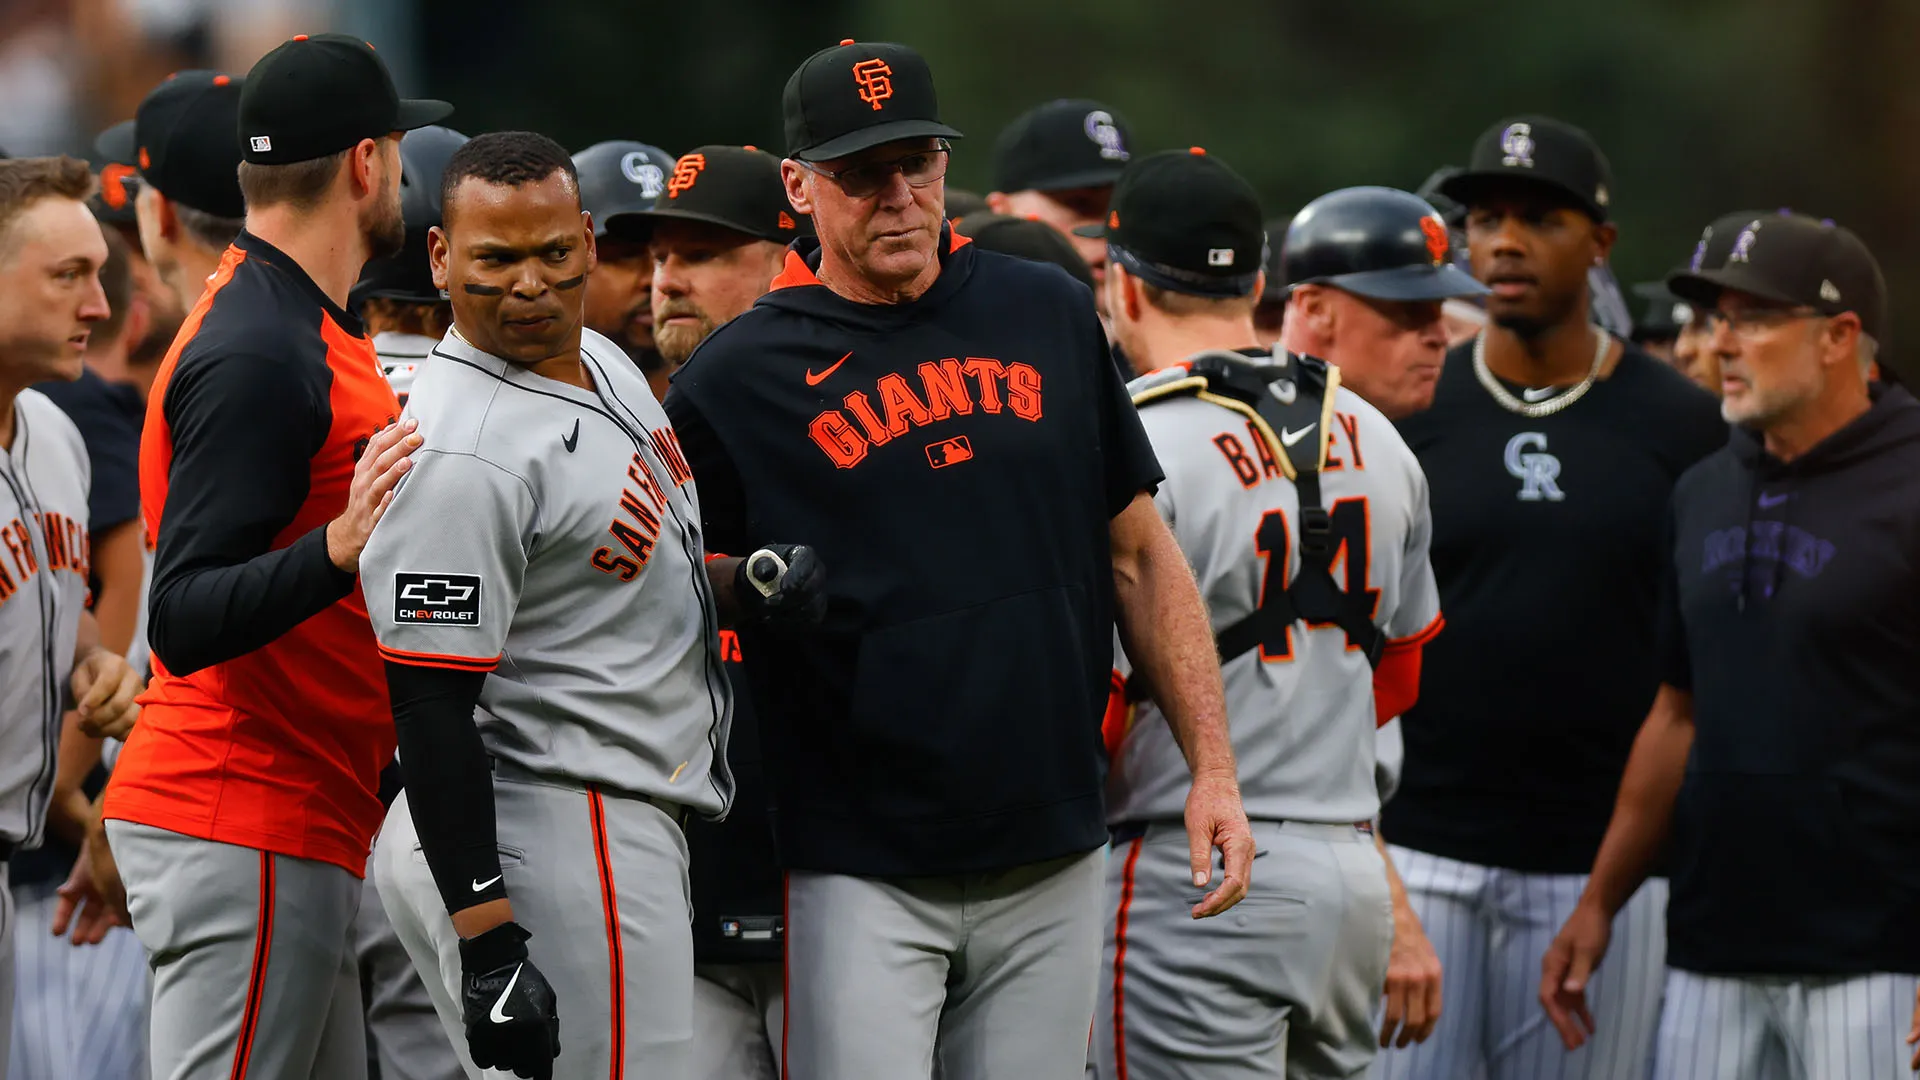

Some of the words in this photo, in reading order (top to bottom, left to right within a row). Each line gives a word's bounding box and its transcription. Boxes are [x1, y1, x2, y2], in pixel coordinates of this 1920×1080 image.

[852, 57, 893, 111] SF
[668, 153, 706, 199] SF
[808, 356, 1043, 469] GIANTS
[1503, 431, 1566, 501] CR
[591, 487, 662, 583] SAN
[399, 609, 475, 620] CHEVROLET
[1254, 496, 1382, 665] 14
